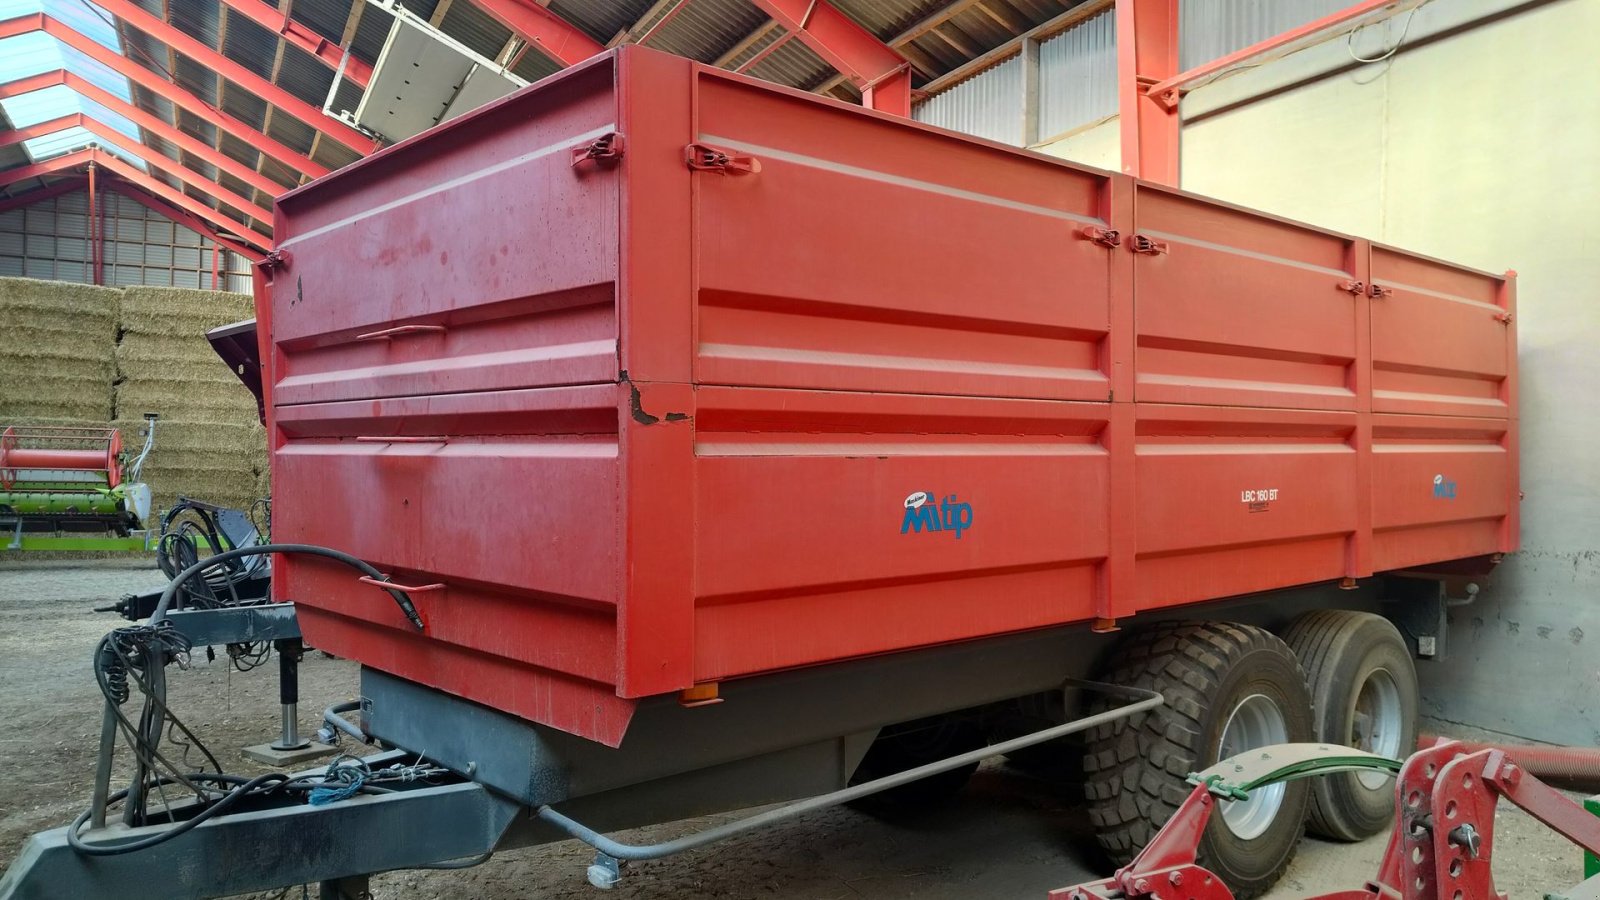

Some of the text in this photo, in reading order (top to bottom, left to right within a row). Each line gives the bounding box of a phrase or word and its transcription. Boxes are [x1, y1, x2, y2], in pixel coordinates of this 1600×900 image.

[1241, 489, 1279, 502] LBC 160 BT
